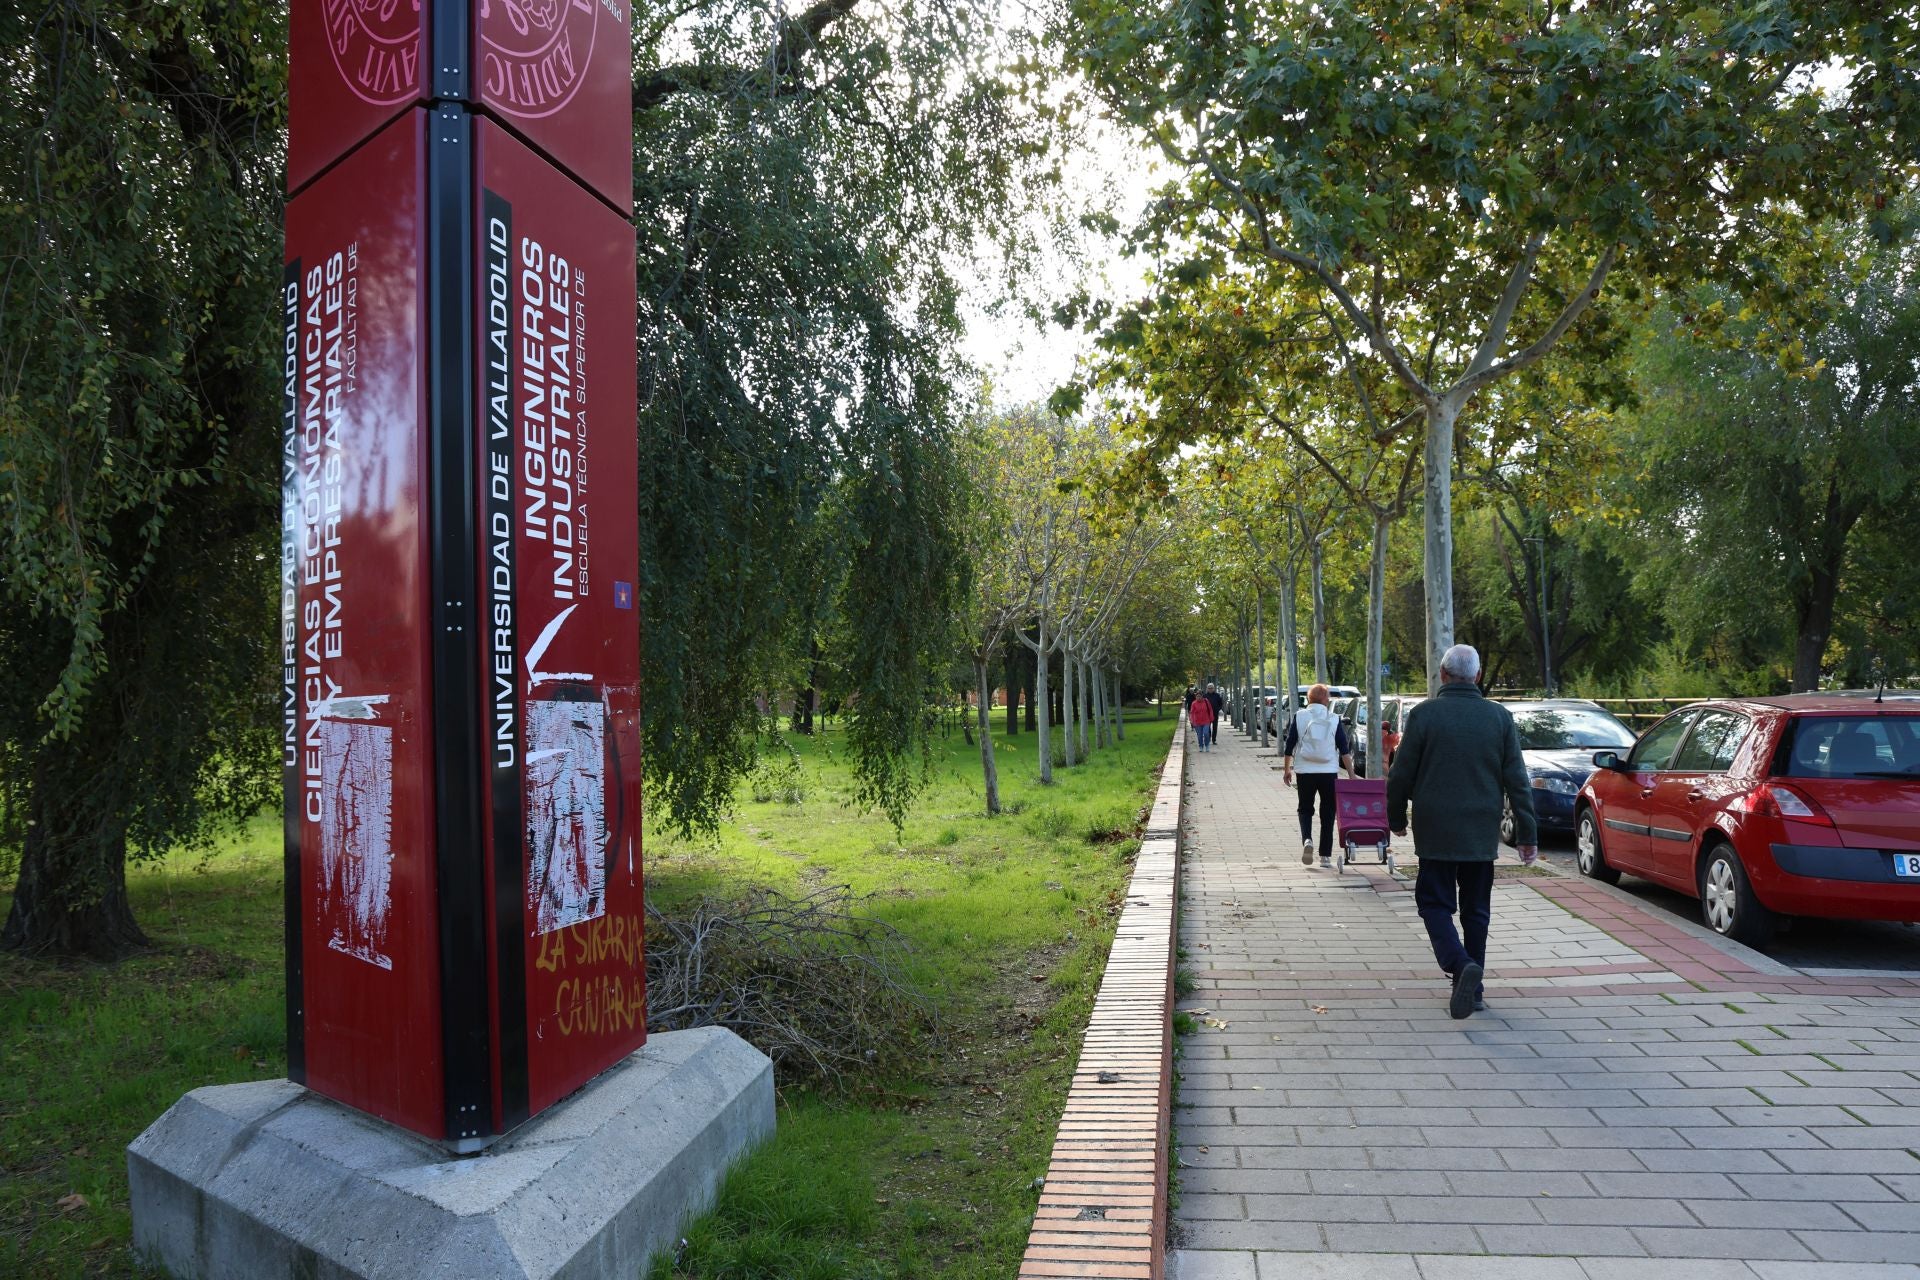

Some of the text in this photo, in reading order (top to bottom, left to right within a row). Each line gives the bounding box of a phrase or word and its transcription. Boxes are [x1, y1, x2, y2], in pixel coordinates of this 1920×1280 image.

[324, 251, 343, 706] Y EMPRESARIALES
[346, 241, 358, 393] FACULTAD DE
[522, 237, 547, 540] INGENIEROS
[549, 253, 573, 600] INDUSTRIALES
[574, 267, 589, 596] ESCUELA TÉCNICA SUPERIOR DE
[284, 282, 298, 767] UNIVERSIDAD DE VALLADOLID
[303, 265, 323, 823] CIENCIAS ECONÓMICAS
[490, 217, 514, 768] UNIVERSIDAD DE VALLADOLID
[536, 929, 566, 972] LA
